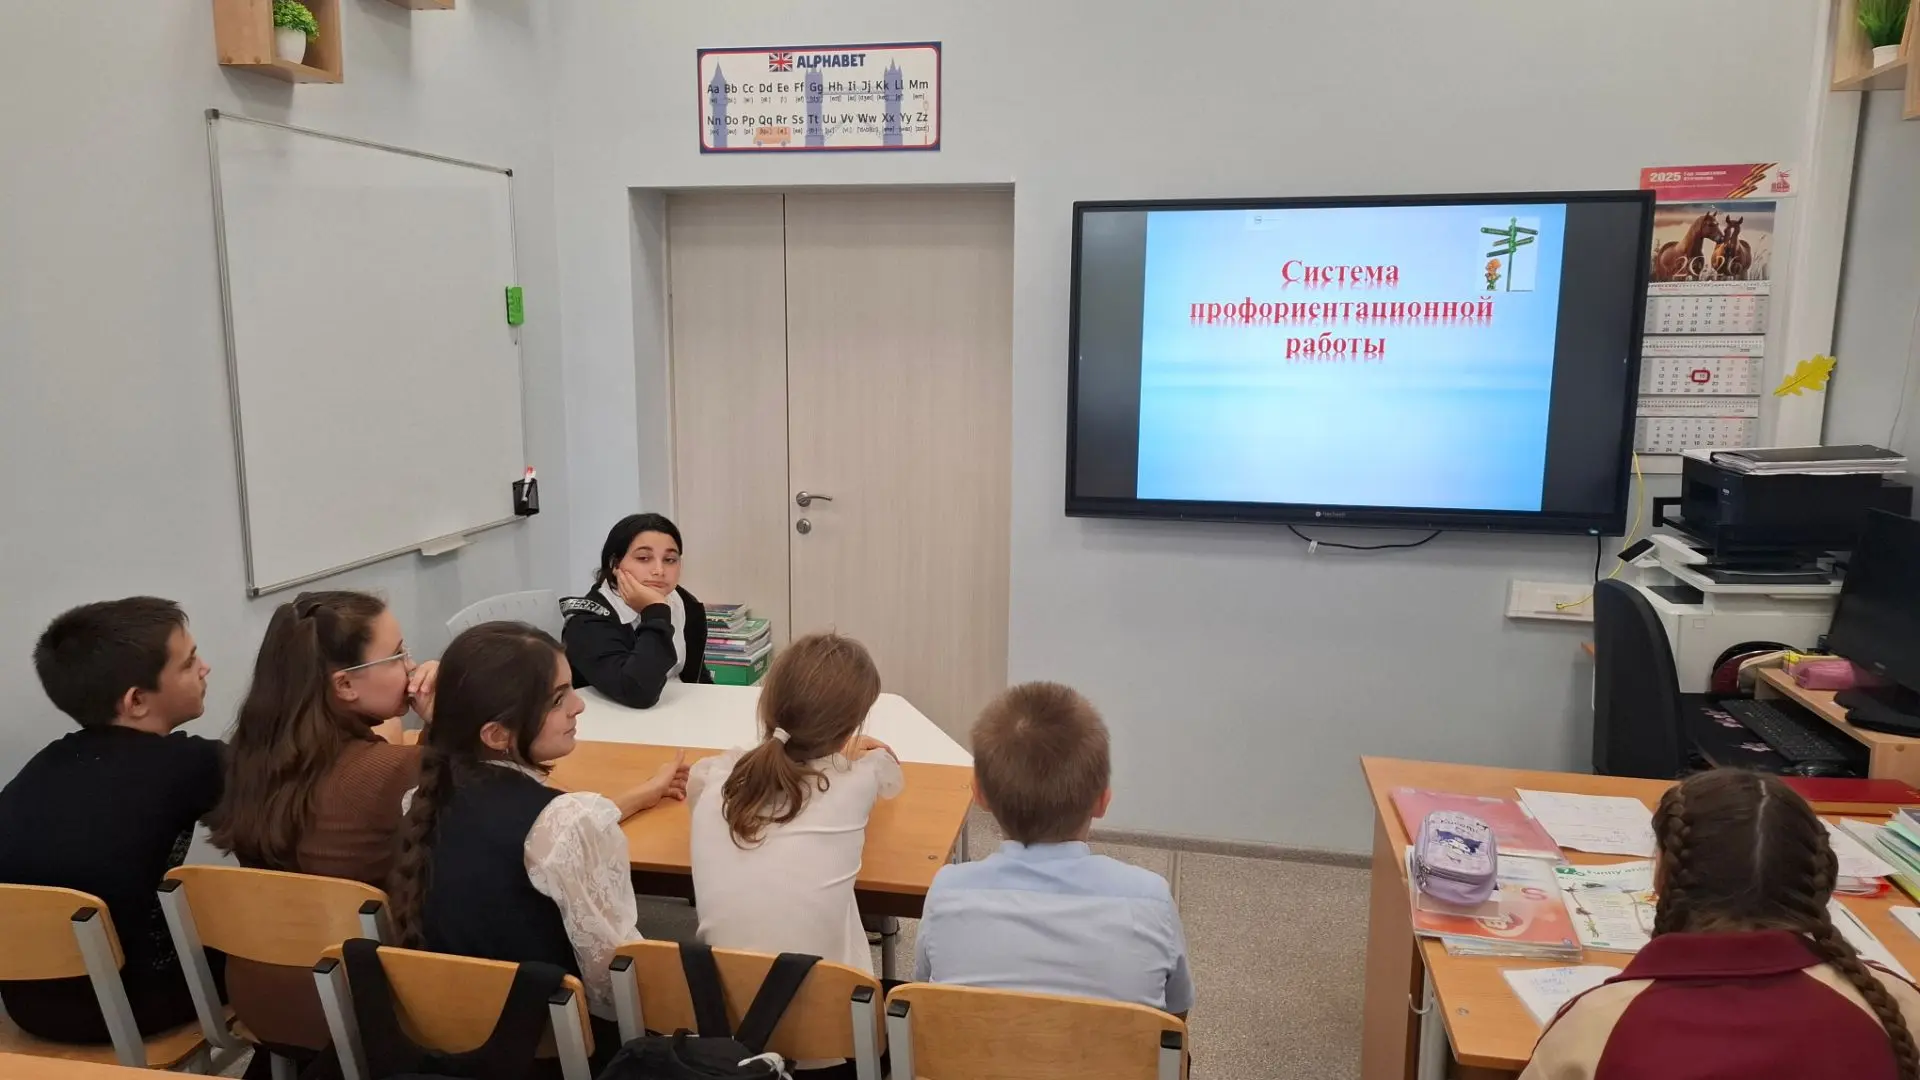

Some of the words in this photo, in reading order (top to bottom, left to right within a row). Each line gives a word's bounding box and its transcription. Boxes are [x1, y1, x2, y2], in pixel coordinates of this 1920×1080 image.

[797, 54, 866, 68] ALPHABET
[708, 84, 720, 94] Aa
[724, 84, 738, 94] Bb
[742, 84, 754, 93] Cc
[759, 82, 772, 92] Dd
[778, 82, 789, 92] Ee
[794, 82, 804, 92] Ff
[810, 82, 824, 94] Gg
[828, 82, 842, 91] Hh
[848, 80, 856, 91] Ii
[862, 80, 871, 93] Jj
[876, 80, 890, 90] Kk
[895, 80, 904, 90] Ll
[910, 80, 928, 89] Mm
[708, 116, 720, 125] Nn
[724, 116, 738, 125] Oo
[742, 116, 755, 127] Pp
[759, 115, 772, 126] Qq
[776, 115, 788, 124] Rr
[792, 114, 804, 124] Ss
[808, 114, 818, 124] Tt
[822, 114, 836, 124] Uu
[840, 114, 854, 123] Vv
[858, 114, 877, 122] Ww
[882, 112, 894, 122] Xx
[900, 112, 912, 124] Yy
[916, 112, 928, 122] Zz
[1650, 172, 1682, 182] 2025
[1281, 260, 1400, 284] Система
[1672, 256, 1742, 277] 2026
[1190, 296, 1494, 324] профориентационной
[1286, 332, 1386, 358] работы
